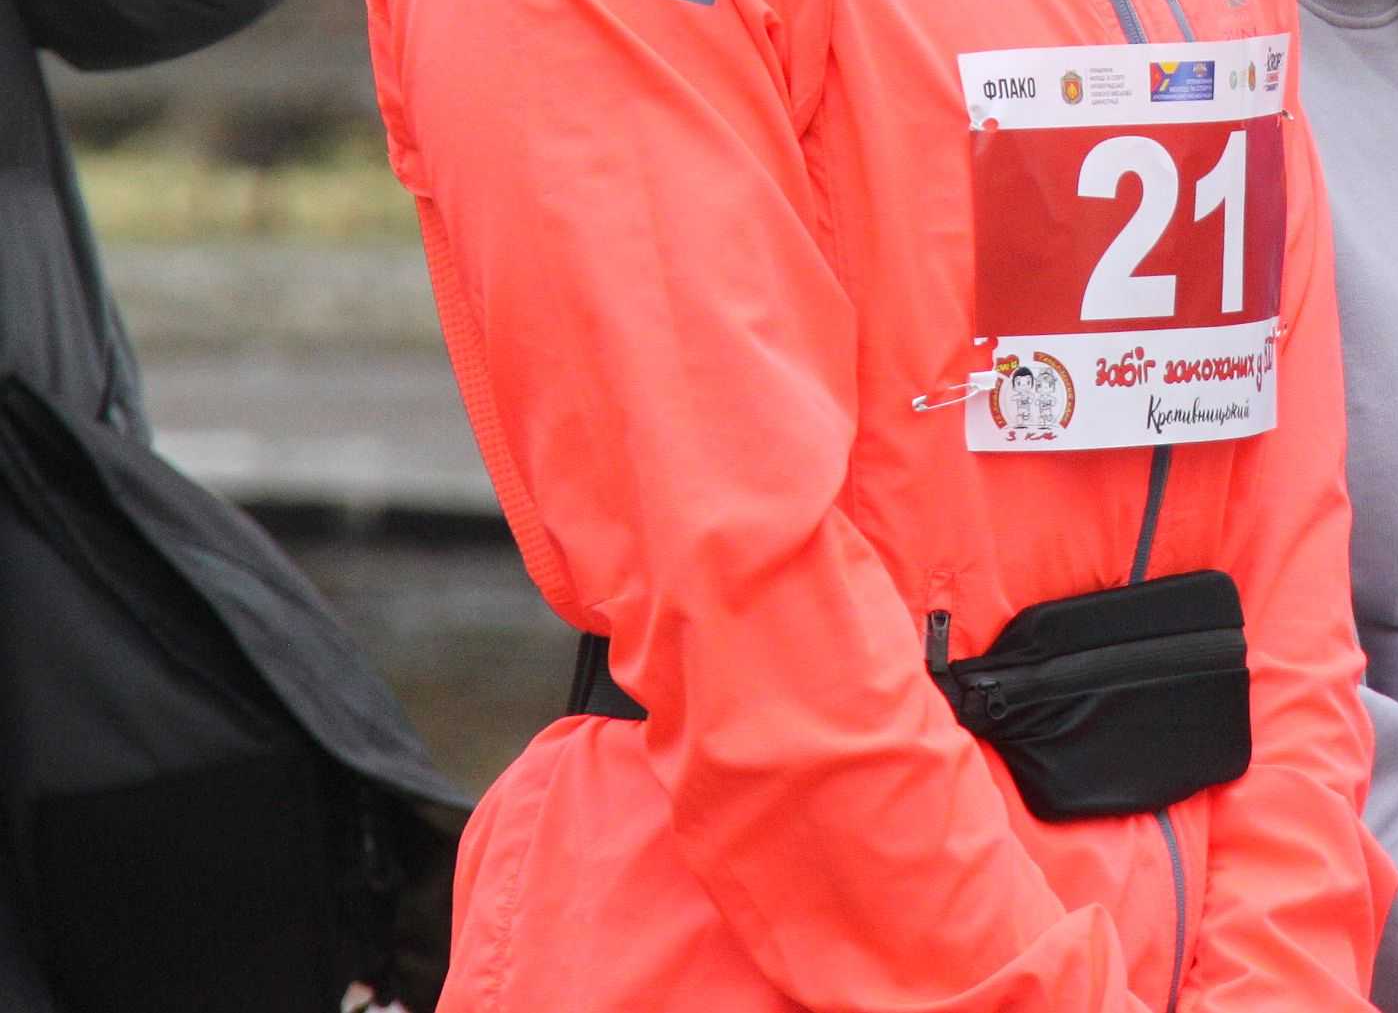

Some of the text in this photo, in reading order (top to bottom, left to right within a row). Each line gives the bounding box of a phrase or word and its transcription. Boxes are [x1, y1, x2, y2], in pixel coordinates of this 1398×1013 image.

[983, 77, 1036, 100] ФЛАКО
[1077, 130, 1247, 321] 21
[1095, 346, 1156, 388] забіг
[1163, 353, 1255, 385] закоханих
